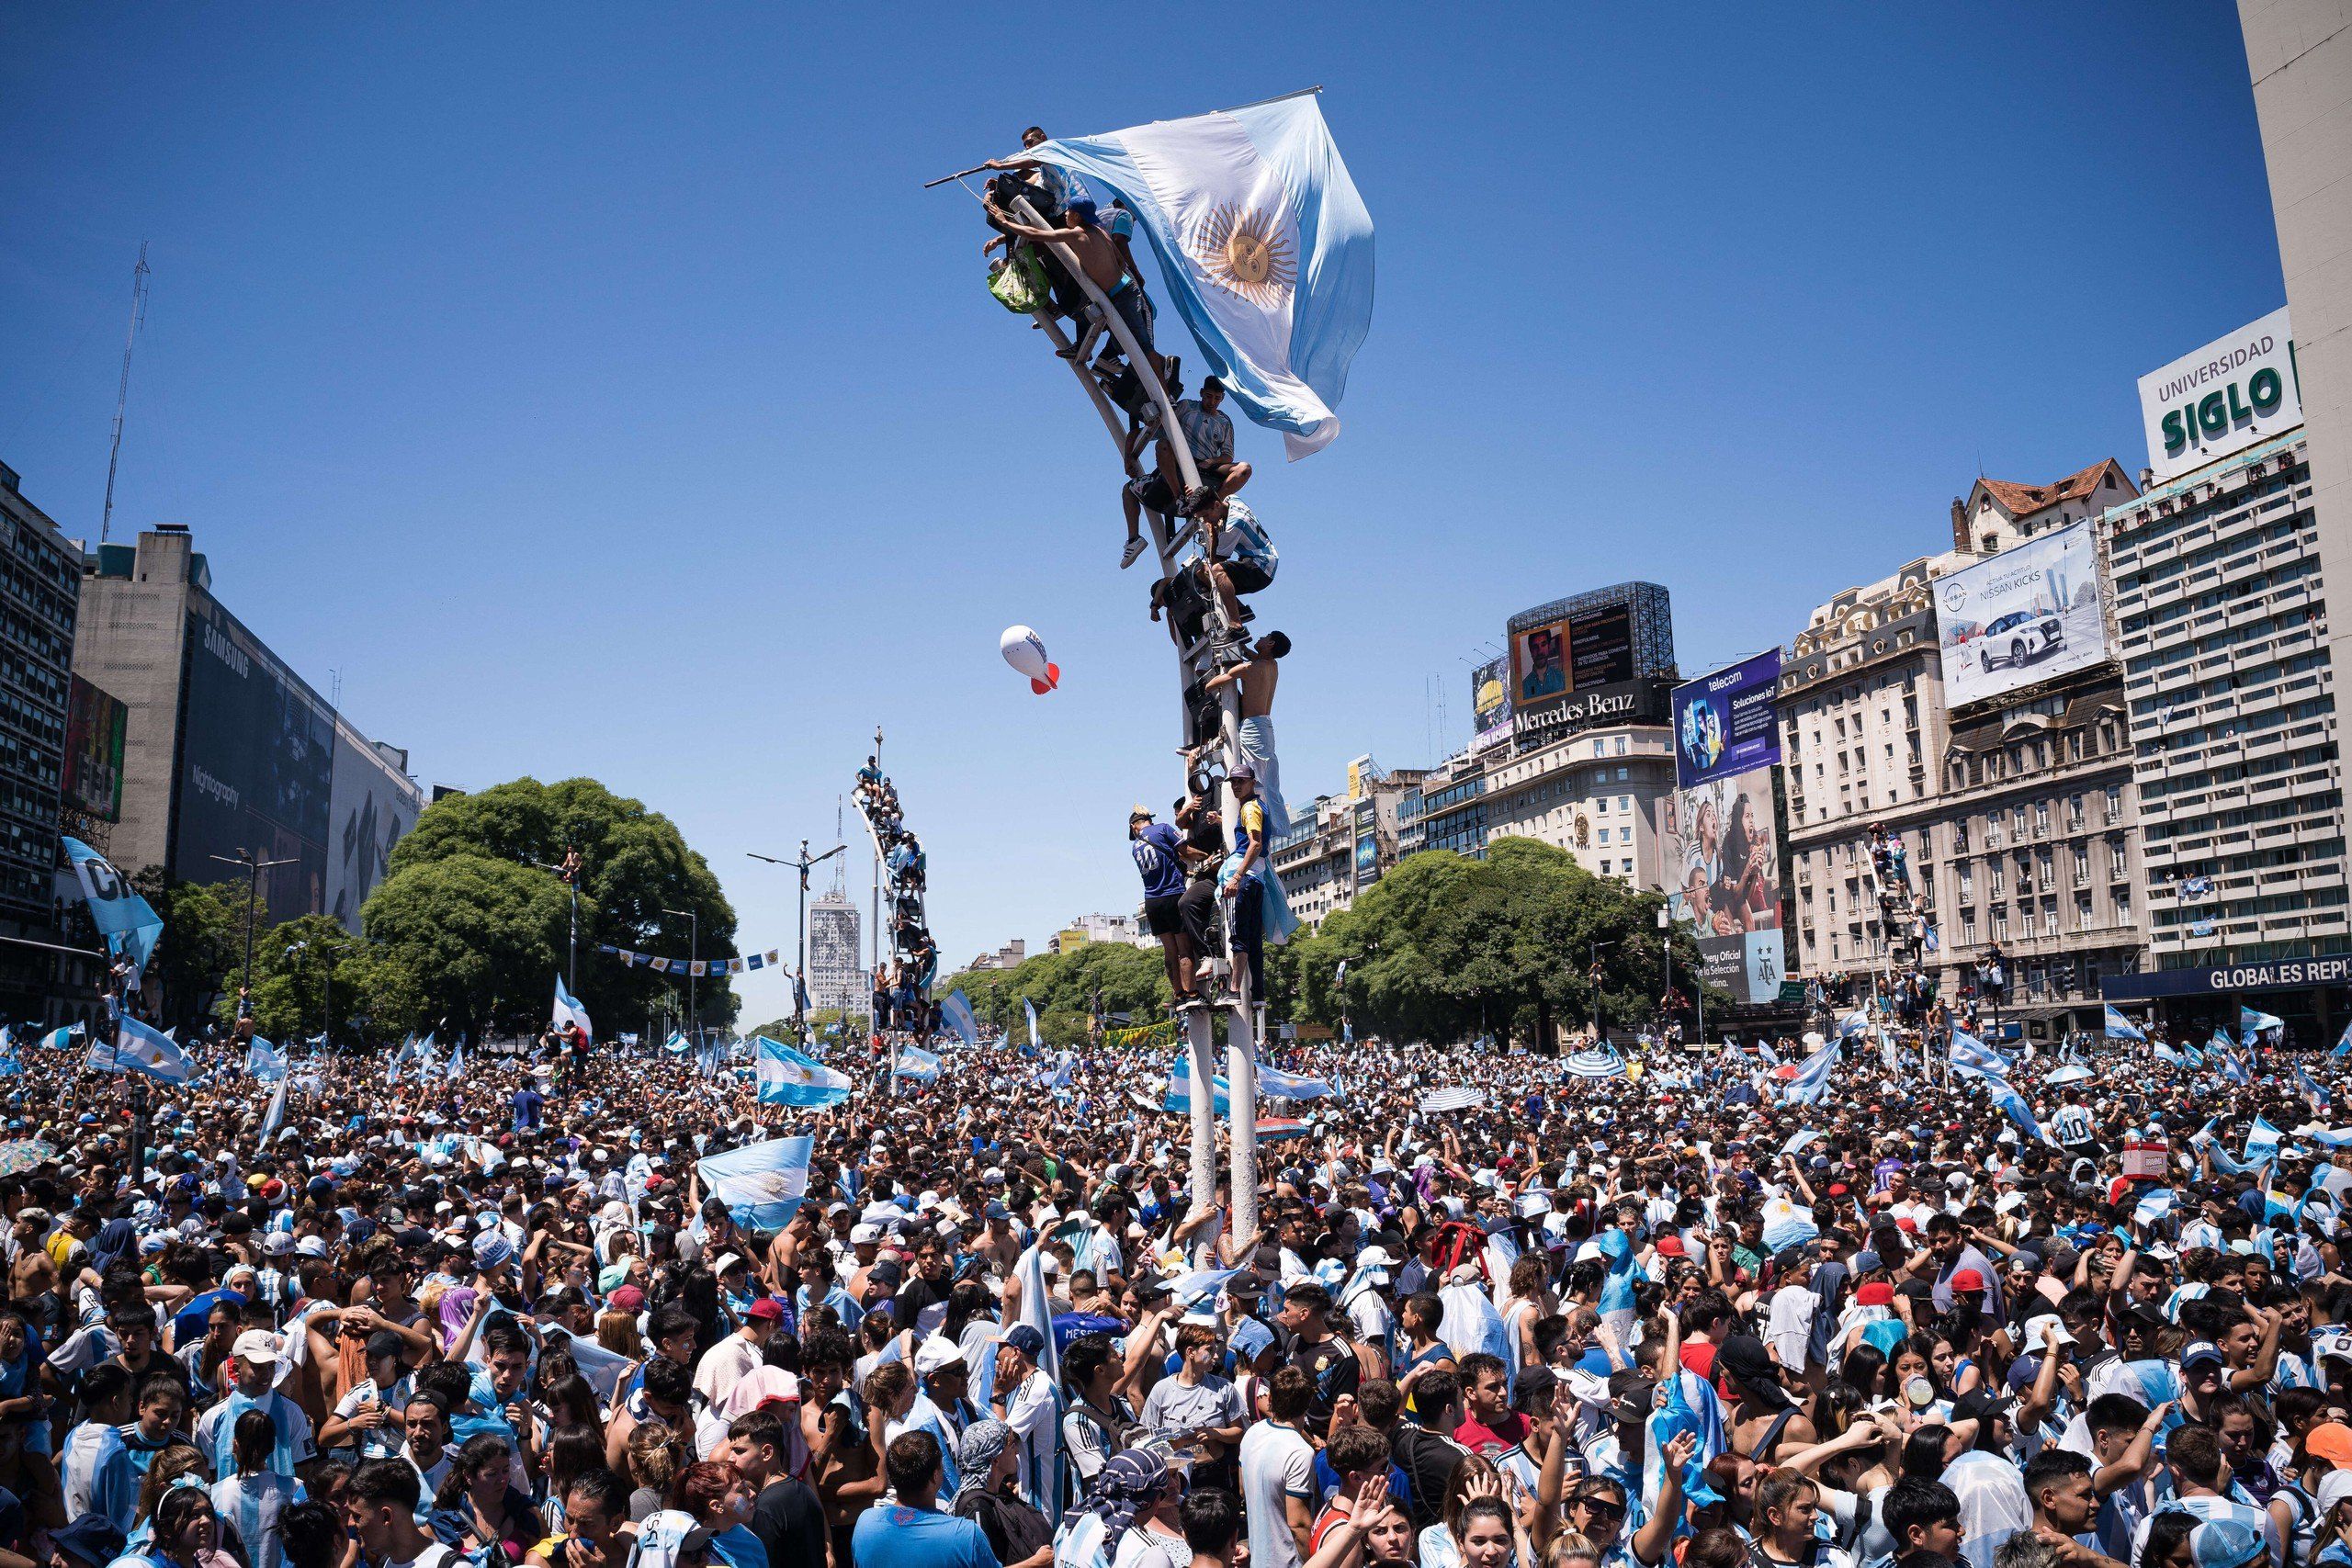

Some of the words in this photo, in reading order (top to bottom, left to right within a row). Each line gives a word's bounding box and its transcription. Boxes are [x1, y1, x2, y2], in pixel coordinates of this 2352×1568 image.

[2159, 335, 2274, 402] UNIVERSIDAD
[2161, 367, 2282, 450] SIGLO
[1980, 582, 2012, 601] NISSAN
[2014, 570, 2041, 589] KICKS
[204, 623, 250, 680] SAMSUNG
[1709, 671, 1743, 692] telecom
[1733, 692, 1766, 710] Soluciones
[1766, 686, 1775, 698] IoT
[1515, 694, 1635, 734] Mercedes-Benz
[192, 764, 240, 810] Nightography
[1720, 949, 1741, 961] Oficial
[1704, 966, 1710, 976] la
[1710, 963, 1740, 976] Selección
[2064, 1119, 2086, 1141] 10
[1631, 1509, 1645, 1529] 10
